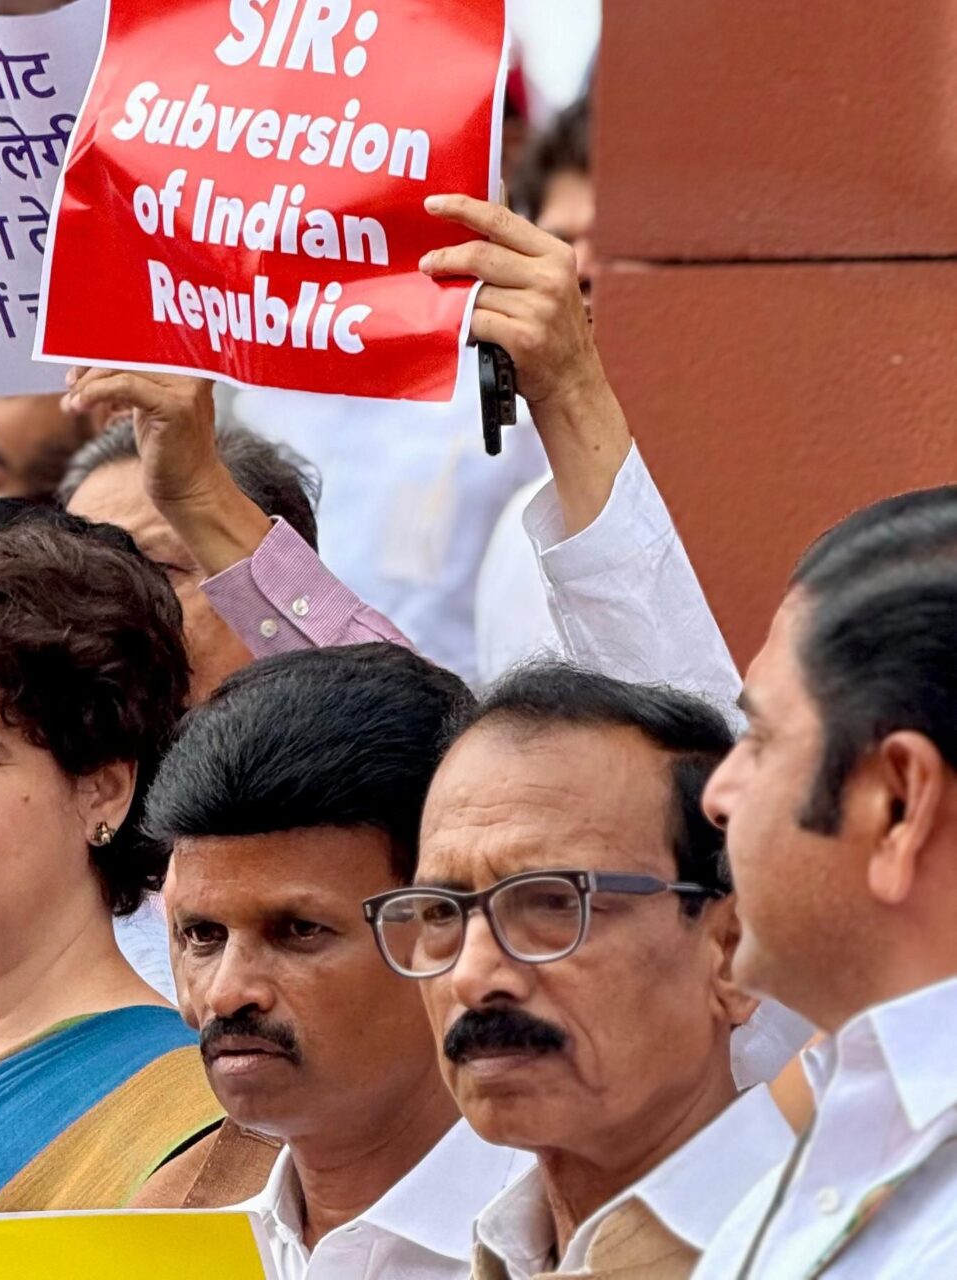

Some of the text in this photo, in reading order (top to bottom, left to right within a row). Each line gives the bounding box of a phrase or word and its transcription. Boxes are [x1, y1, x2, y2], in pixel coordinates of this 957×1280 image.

[111, 81, 430, 181] Subversion
[133, 169, 389, 266] of Indian
[147, 259, 372, 354] Republic
